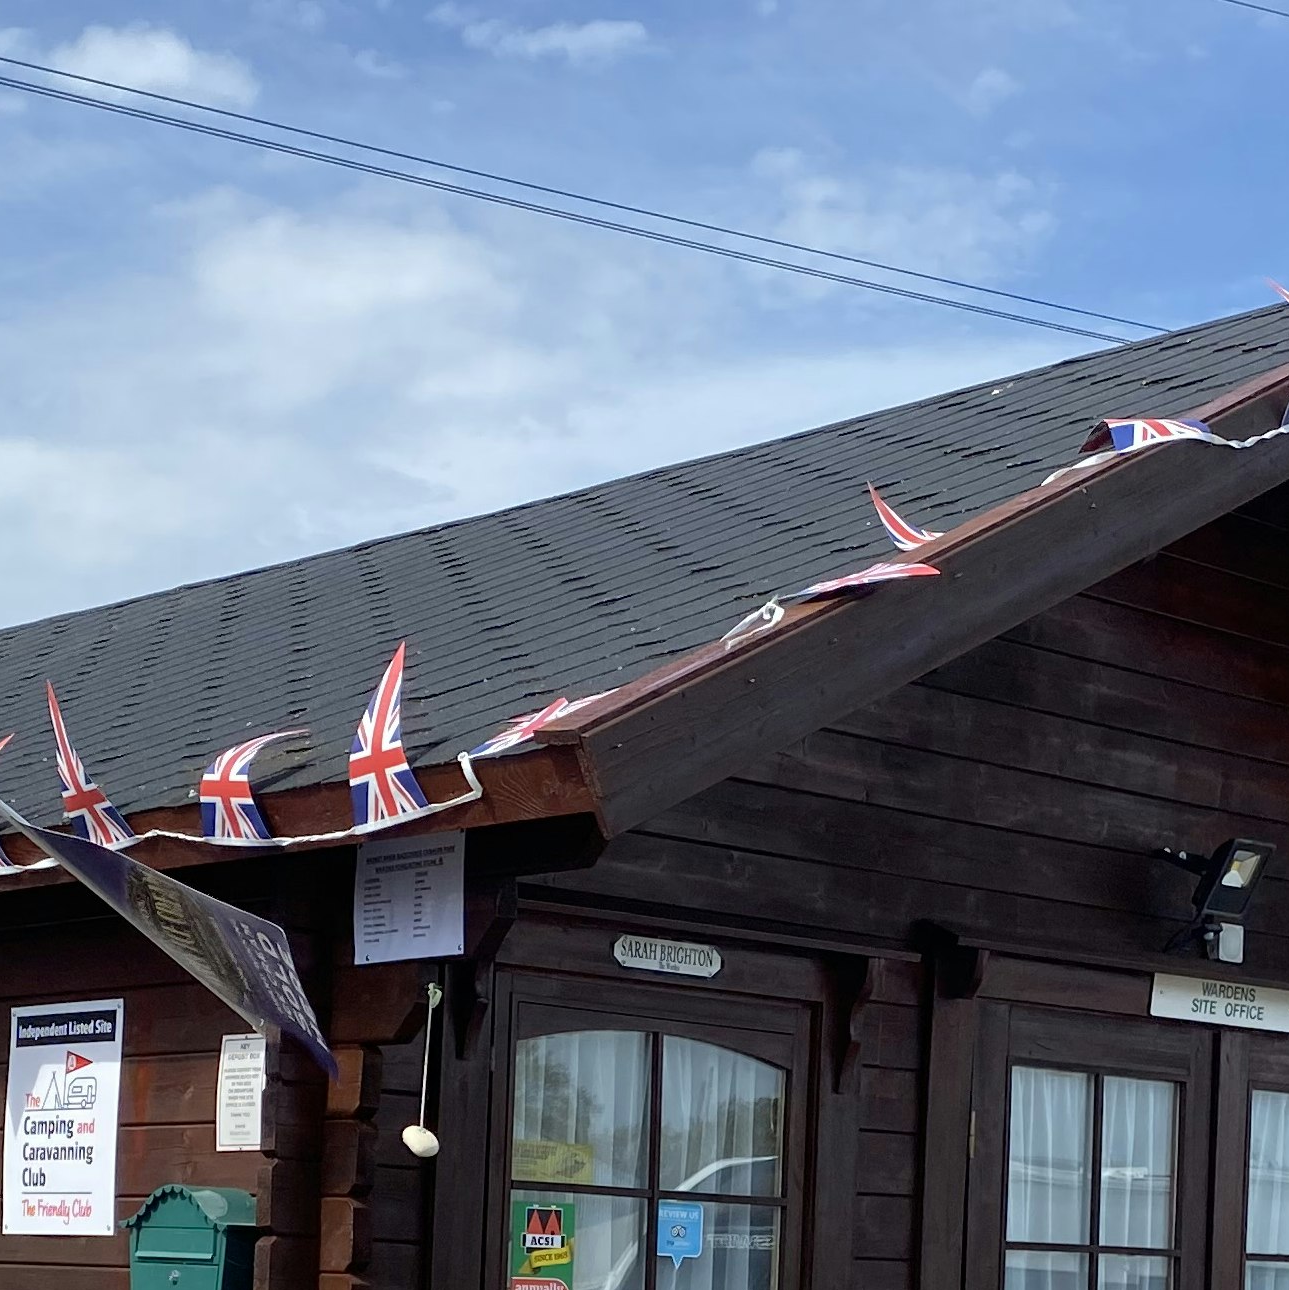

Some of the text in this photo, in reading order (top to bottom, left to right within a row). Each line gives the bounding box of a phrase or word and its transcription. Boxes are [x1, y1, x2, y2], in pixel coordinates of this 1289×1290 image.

[621, 939, 713, 967] SARAH BRIGHTON
[1202, 982, 1256, 1002] WARDENS
[1191, 998, 1264, 1021] SITE OFFICE
[19, 1019, 112, 1040] Independent Listed Site
[26, 1093, 40, 1107] The
[24, 1114, 95, 1139] Camping and
[22, 1141, 94, 1164] Caravanning
[22, 1167, 46, 1187] Club
[22, 1198, 92, 1225] The Friendly Club
[659, 1209, 699, 1220] REVIEW US
[531, 1236, 554, 1246] ACSI
